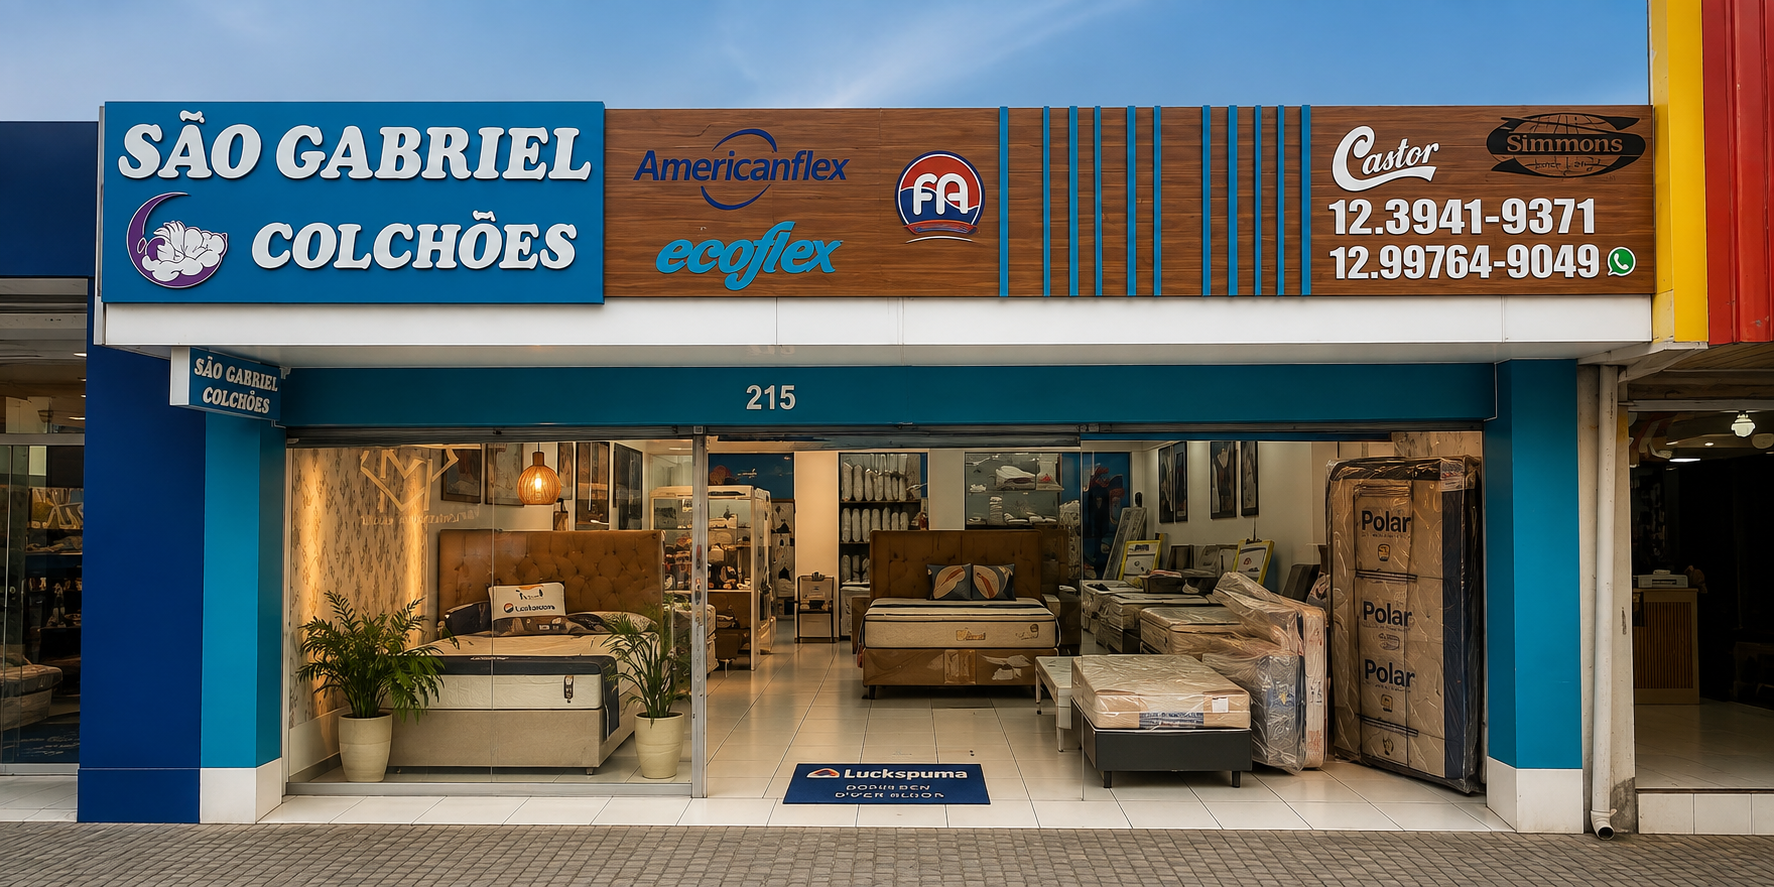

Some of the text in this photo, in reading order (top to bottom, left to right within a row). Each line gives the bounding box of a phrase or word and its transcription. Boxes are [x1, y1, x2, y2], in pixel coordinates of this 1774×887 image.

[118, 109, 592, 181] SÃO GABRIEL
[1331, 125, 1440, 192] Castor
[1506, 134, 1624, 153] Simmons
[633, 149, 850, 182] Americanflex
[912, 172, 969, 216] FA
[1328, 197, 1596, 236] 12.3941-9371
[251, 210, 577, 269] COLCHÕES
[655, 221, 844, 291] ecoflex
[1329, 243, 1600, 280] 12.99764-9049
[194, 355, 278, 392] SÃO GABRIEL
[746, 384, 796, 410] 215
[1361, 510, 1412, 532] Polar
[1363, 600, 1413, 627] Polar
[1364, 658, 1416, 688] Polar
[843, 768, 968, 780] Luckspuma
